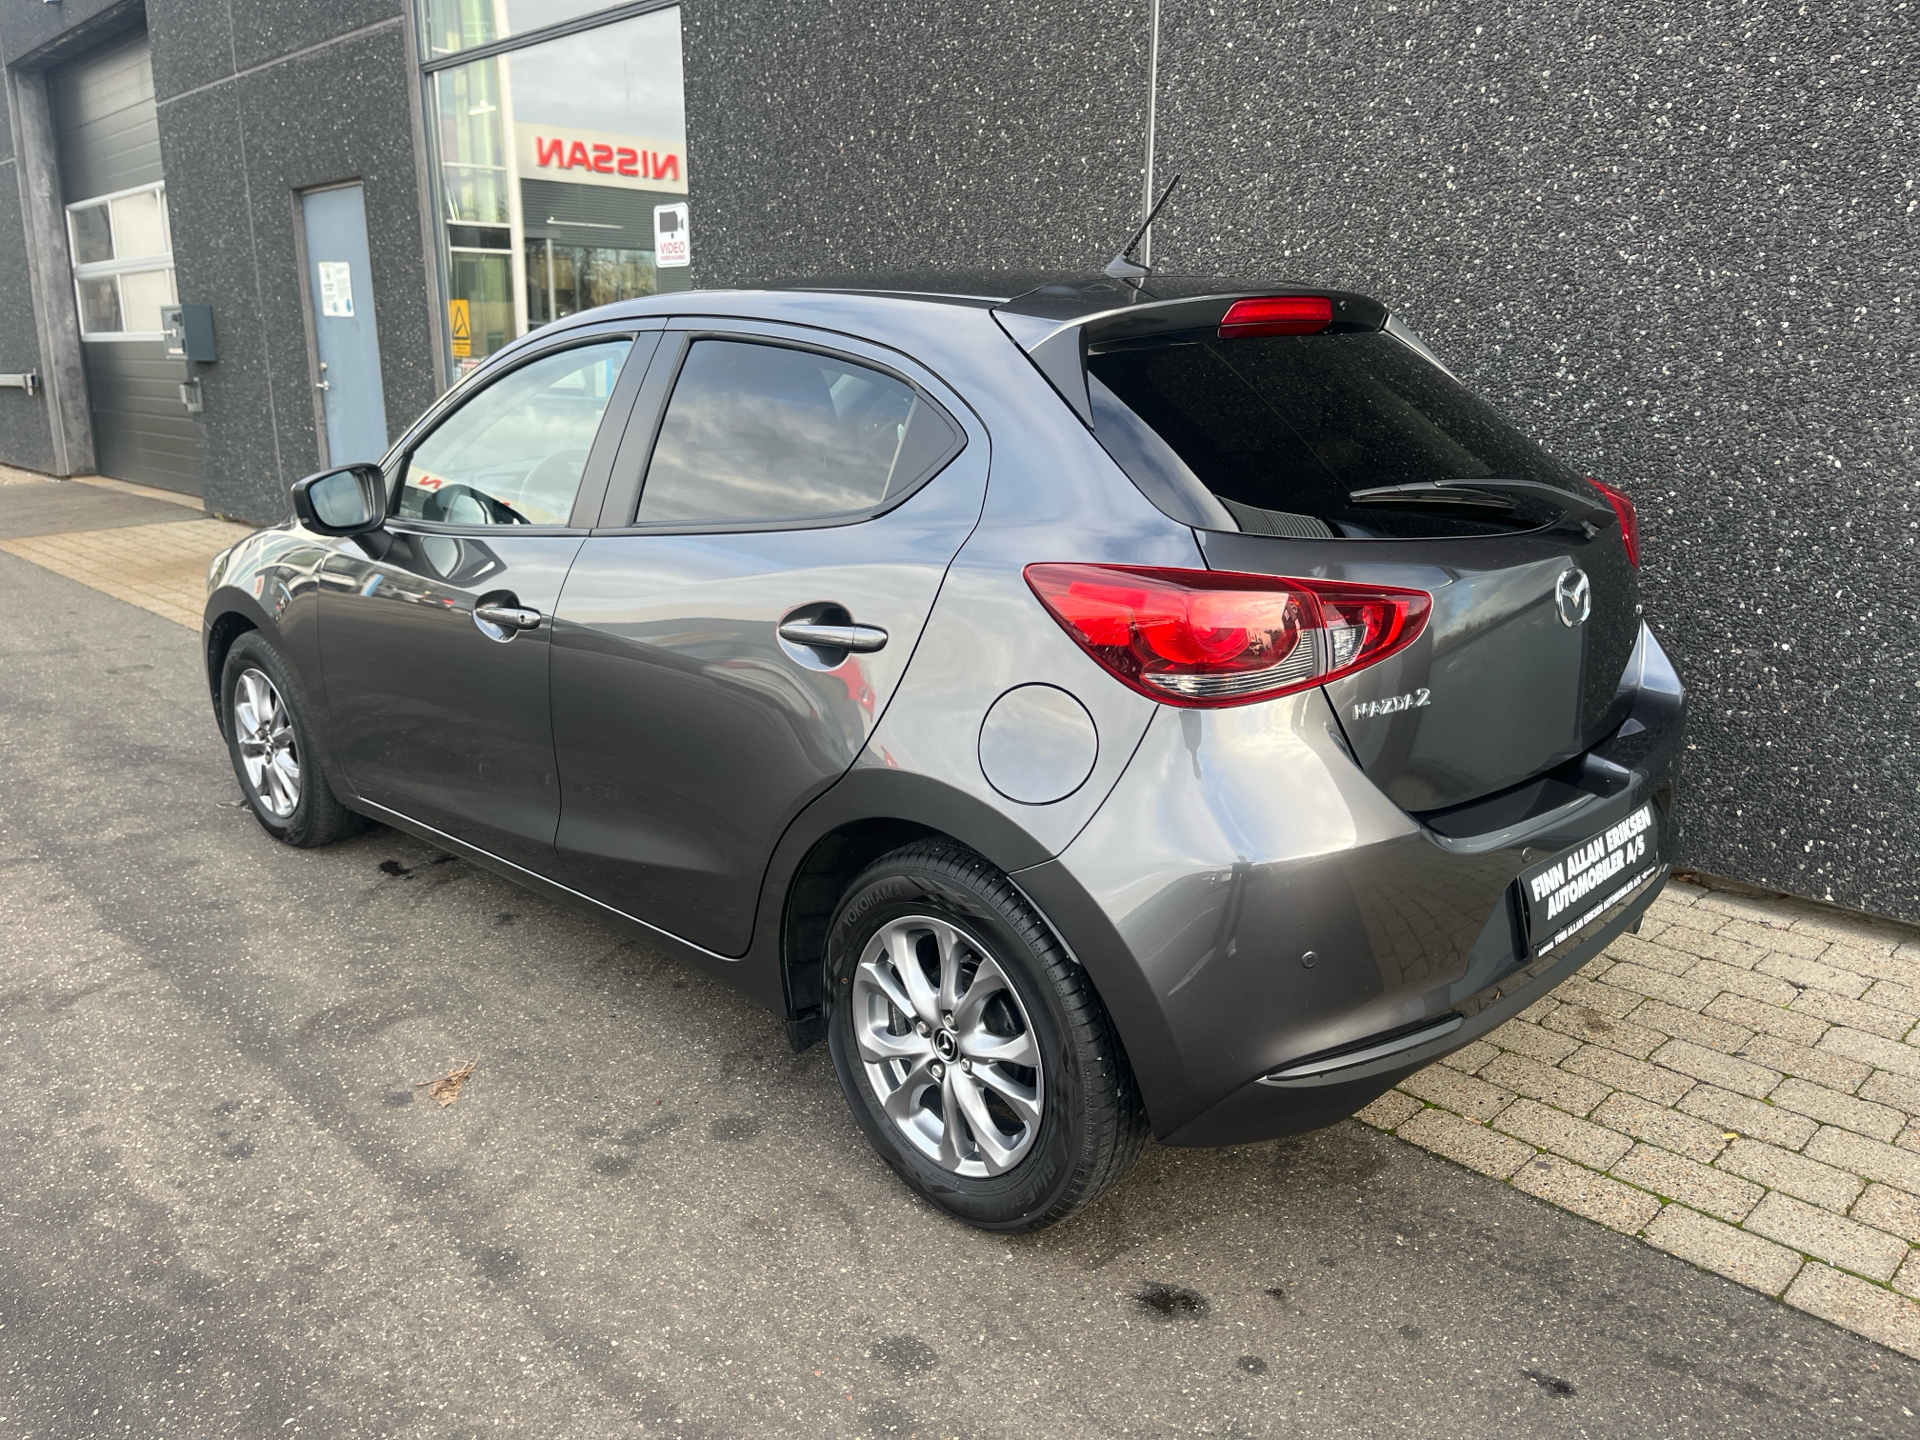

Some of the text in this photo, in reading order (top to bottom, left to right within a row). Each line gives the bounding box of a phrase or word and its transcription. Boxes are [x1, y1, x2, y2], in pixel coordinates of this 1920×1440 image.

[659, 241, 686, 254] VIDEO
[1530, 806, 1651, 903] FINN ALLAN ERIKSEN
[1547, 834, 1645, 921] AUTOMOBILER A/S
[843, 884, 903, 929] YOKOHAMA
[1554, 929, 1568, 946] FINN
[1567, 917, 1584, 937] ALLAN
